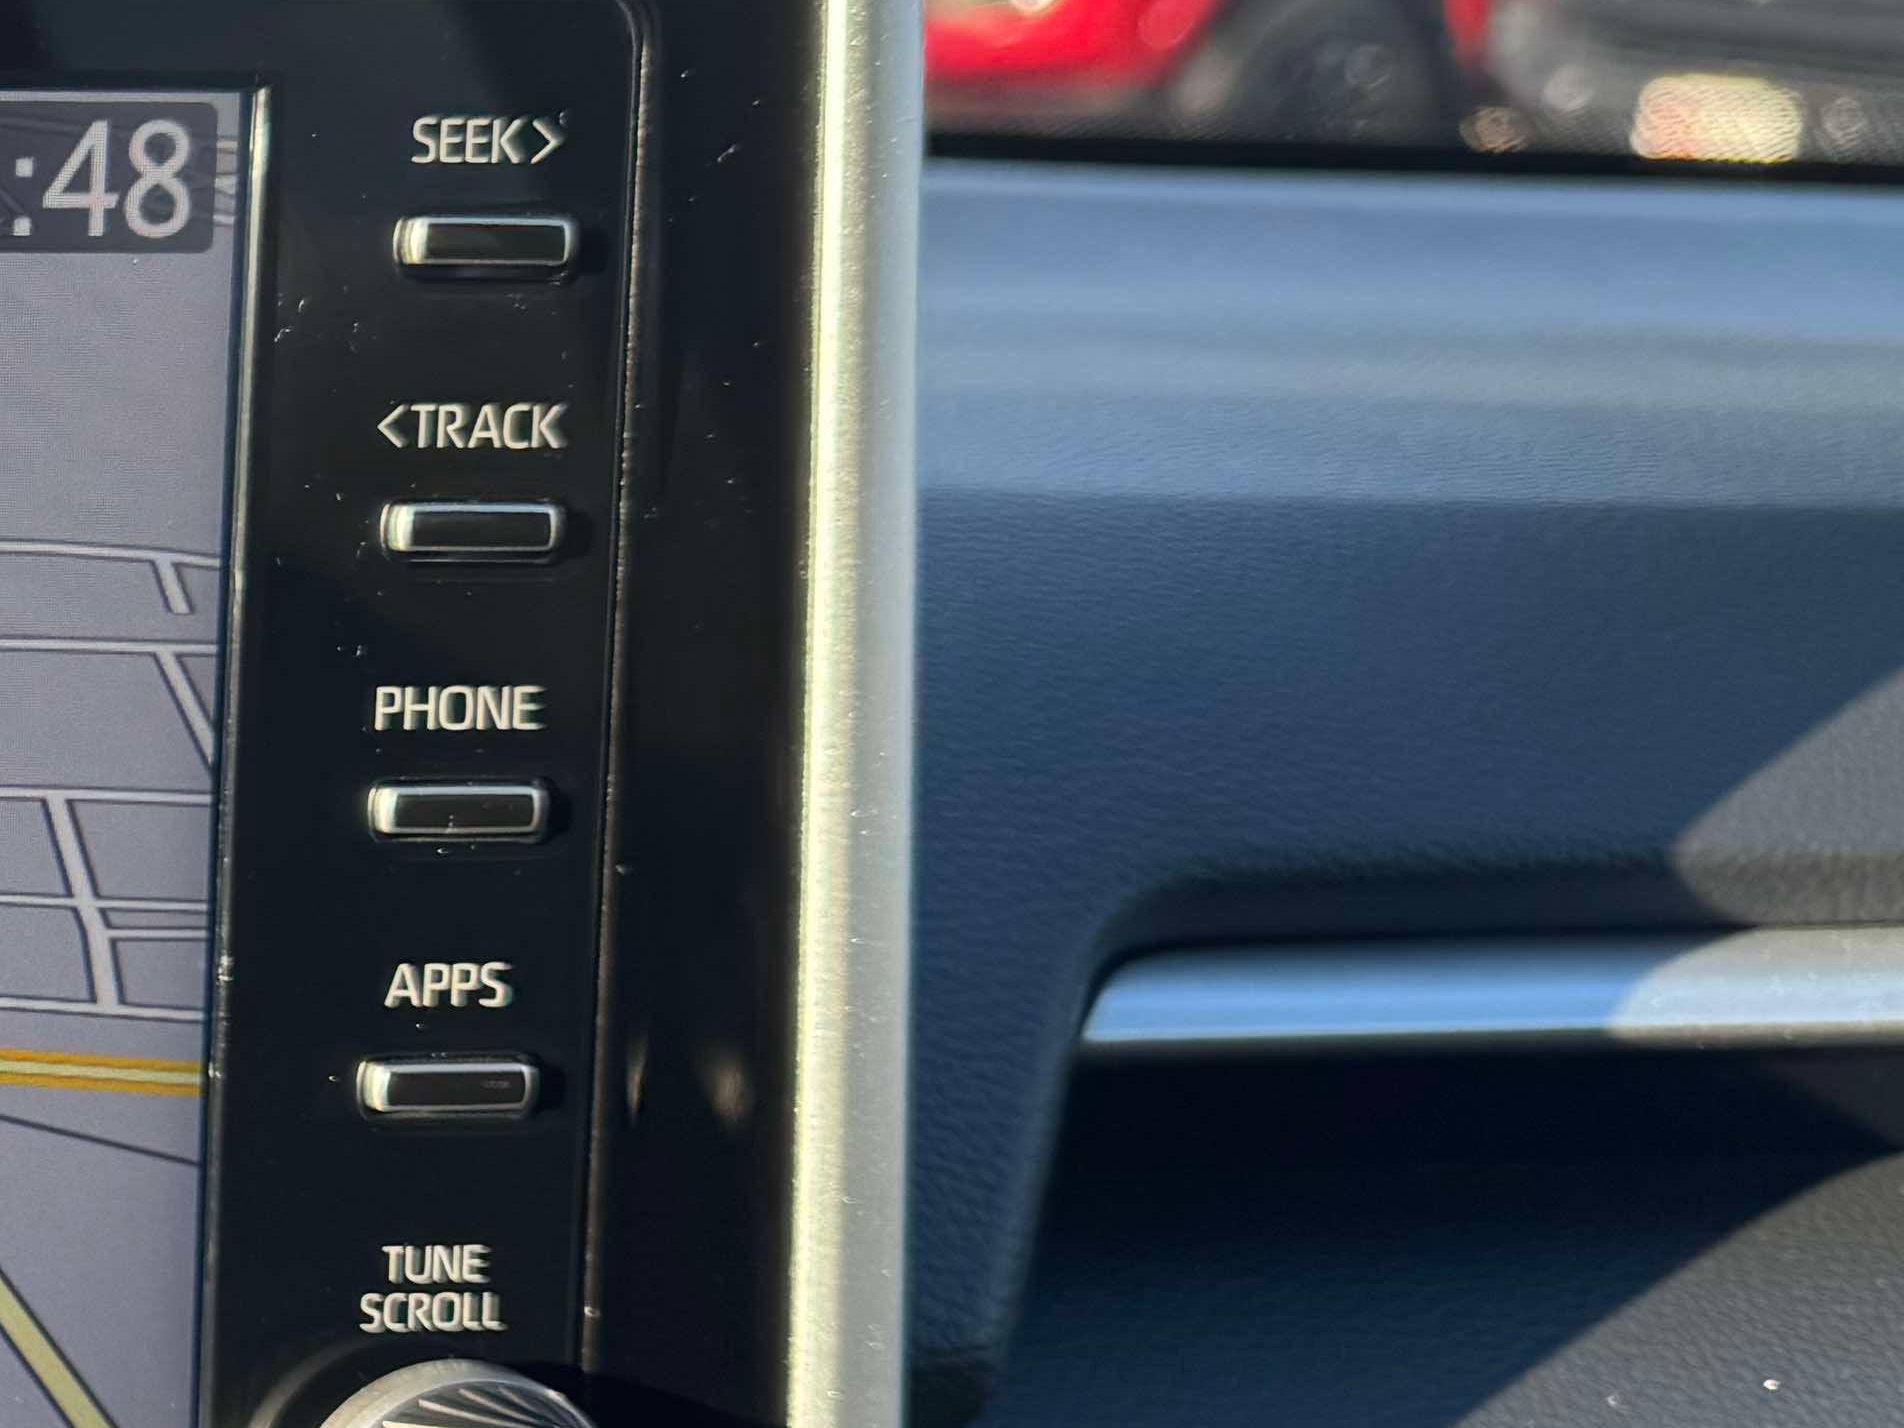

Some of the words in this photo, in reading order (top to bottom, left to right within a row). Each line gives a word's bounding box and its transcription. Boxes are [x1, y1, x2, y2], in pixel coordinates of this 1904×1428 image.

[374, 684, 548, 732] PHONE
[384, 960, 514, 1008] APPS
[382, 1243, 492, 1284] TUNE
[359, 1291, 508, 1333] SCROLL
